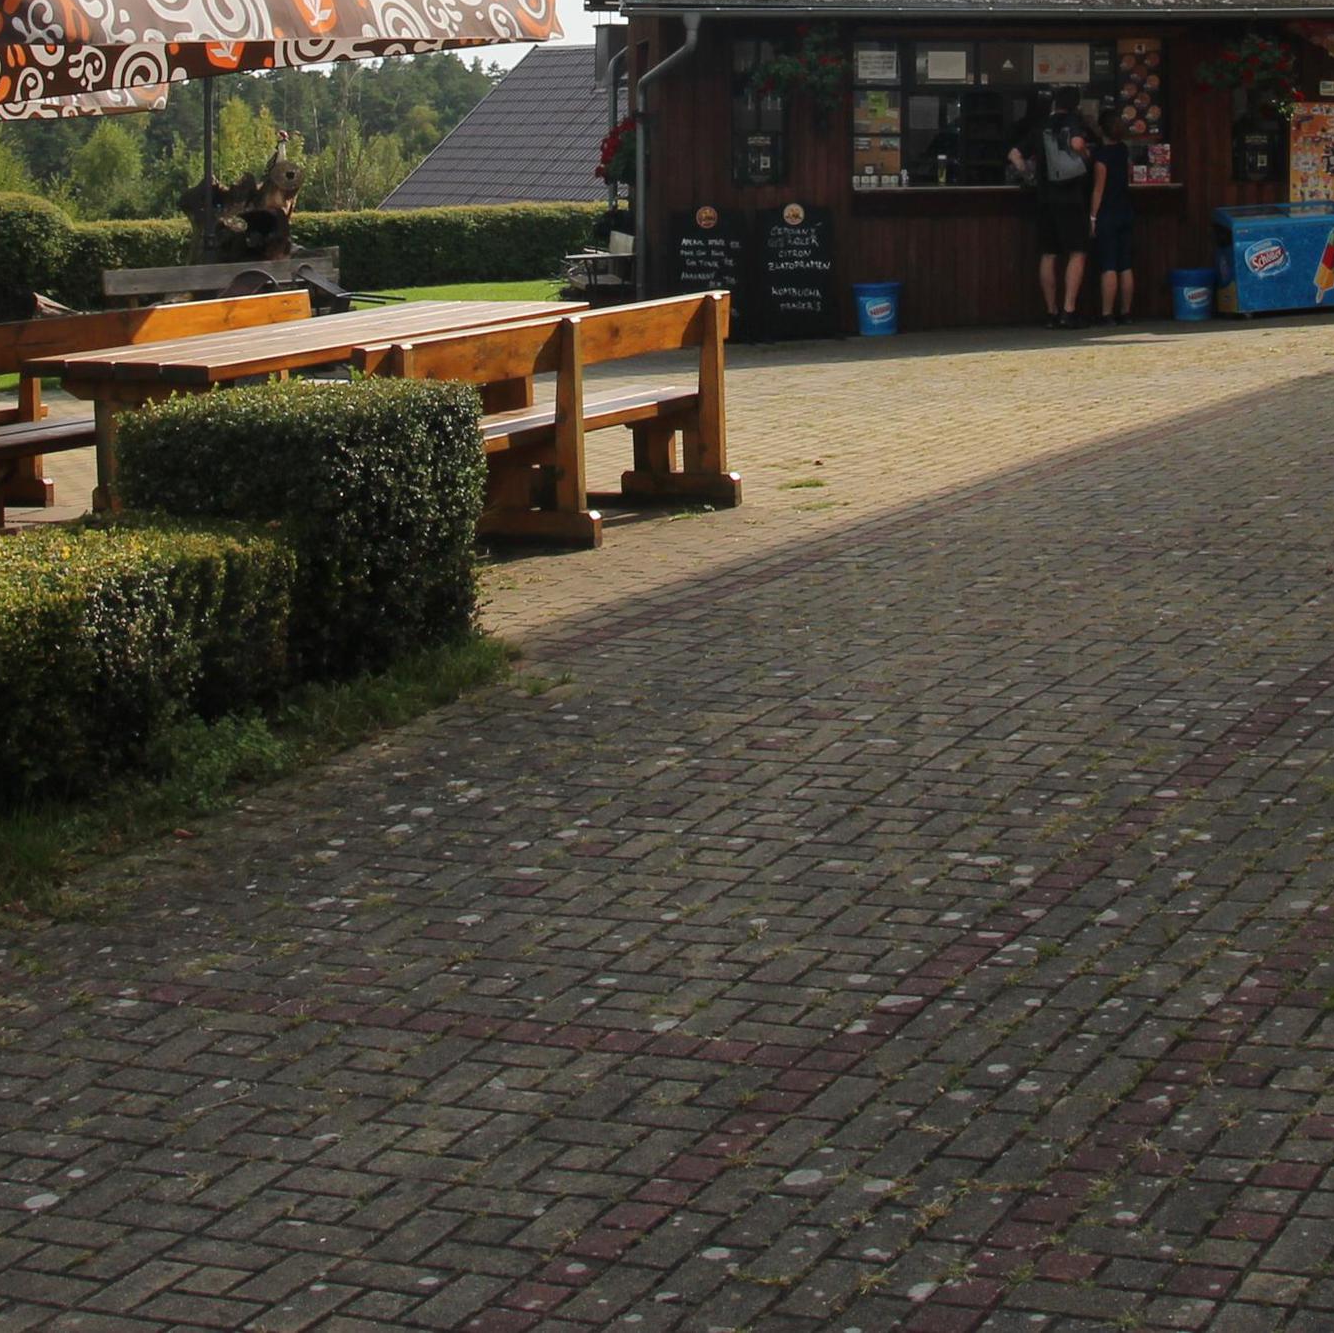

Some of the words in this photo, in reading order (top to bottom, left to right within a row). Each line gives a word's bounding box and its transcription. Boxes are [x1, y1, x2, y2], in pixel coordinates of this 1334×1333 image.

[778, 249, 812, 258] CITRON
[767, 259, 832, 271] ZLATOPRAMEN
[771, 286, 822, 299] KOMBUCHA
